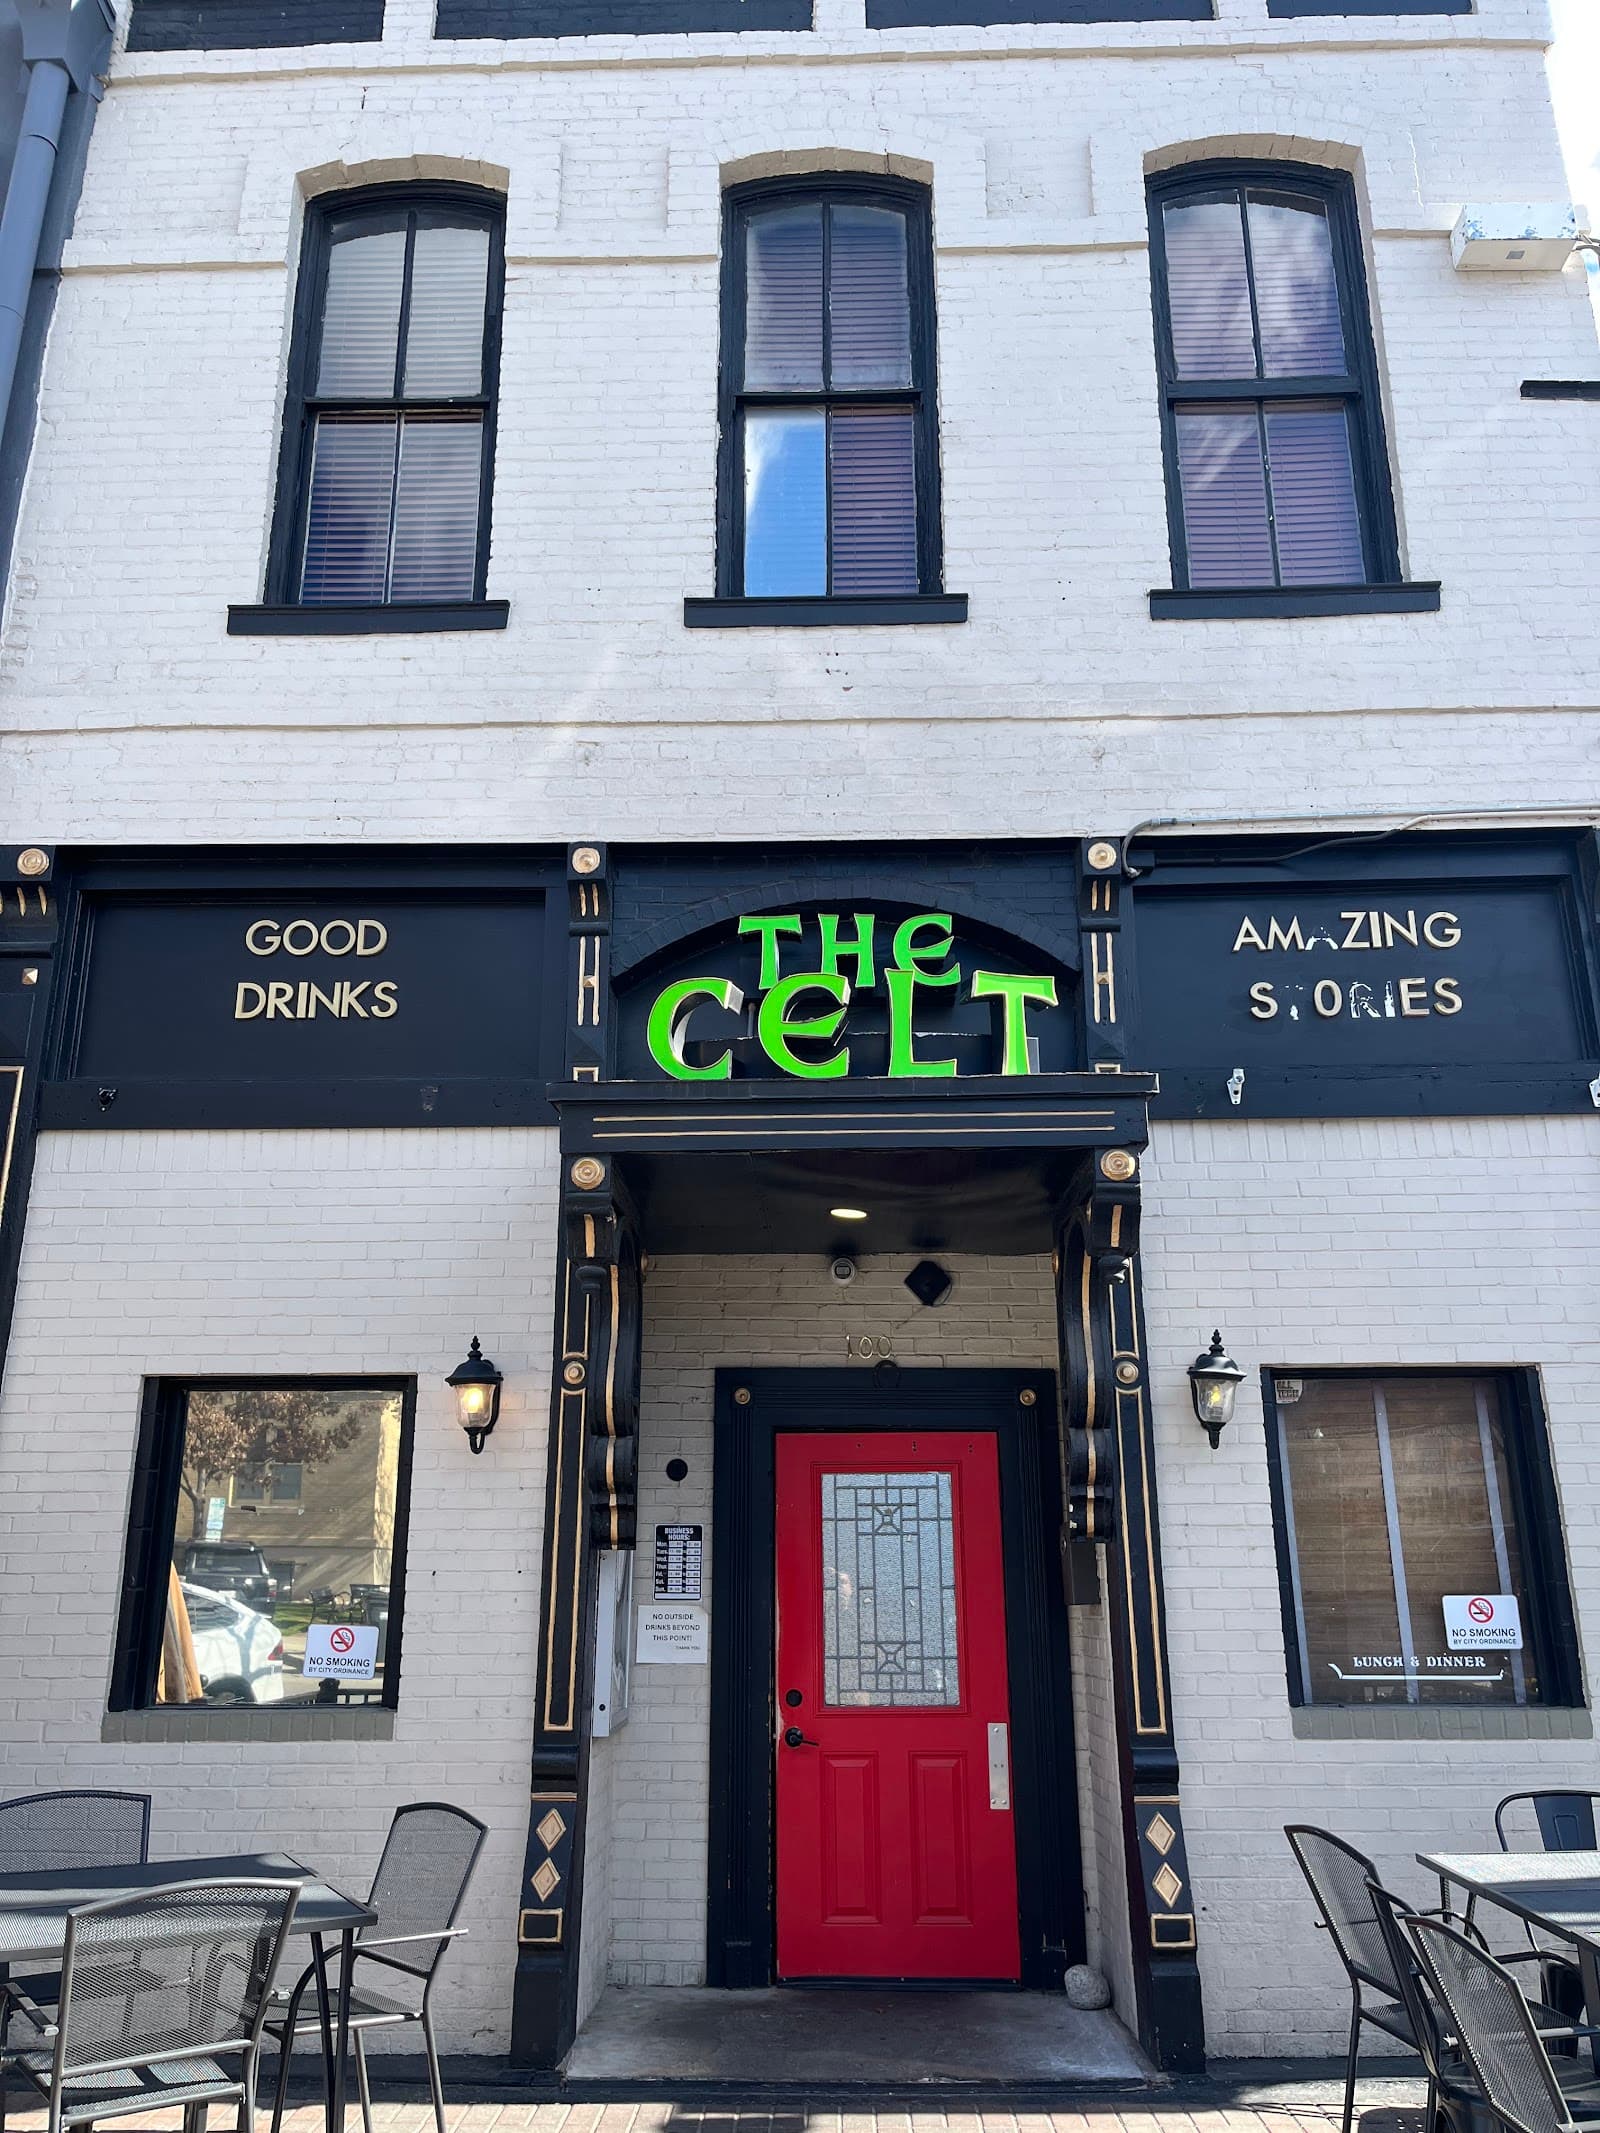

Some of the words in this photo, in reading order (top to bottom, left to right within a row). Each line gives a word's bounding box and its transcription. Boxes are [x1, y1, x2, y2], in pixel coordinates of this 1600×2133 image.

[245, 919, 388, 956] GOOD
[738, 913, 961, 989] THE
[235, 981, 398, 1019] DRINKS
[1250, 977, 1463, 1020] SORIES
[647, 968, 1058, 1081] CELT
[846, 1335, 892, 1359] 100
[652, 1613, 664, 1621] NO
[664, 1613, 695, 1621] OUTSIDE
[1452, 1628, 1467, 1637] NO
[1469, 1628, 1516, 1637] SMOKING
[309, 1656, 324, 1666] NO
[325, 1657, 370, 1668] SMOKING
[333, 1667, 369, 1675] ORDINANCE
[1353, 1655, 1404, 1668] LUNCH
[1410, 1655, 1420, 1667] &
[1426, 1655, 1487, 1668] DINNER
